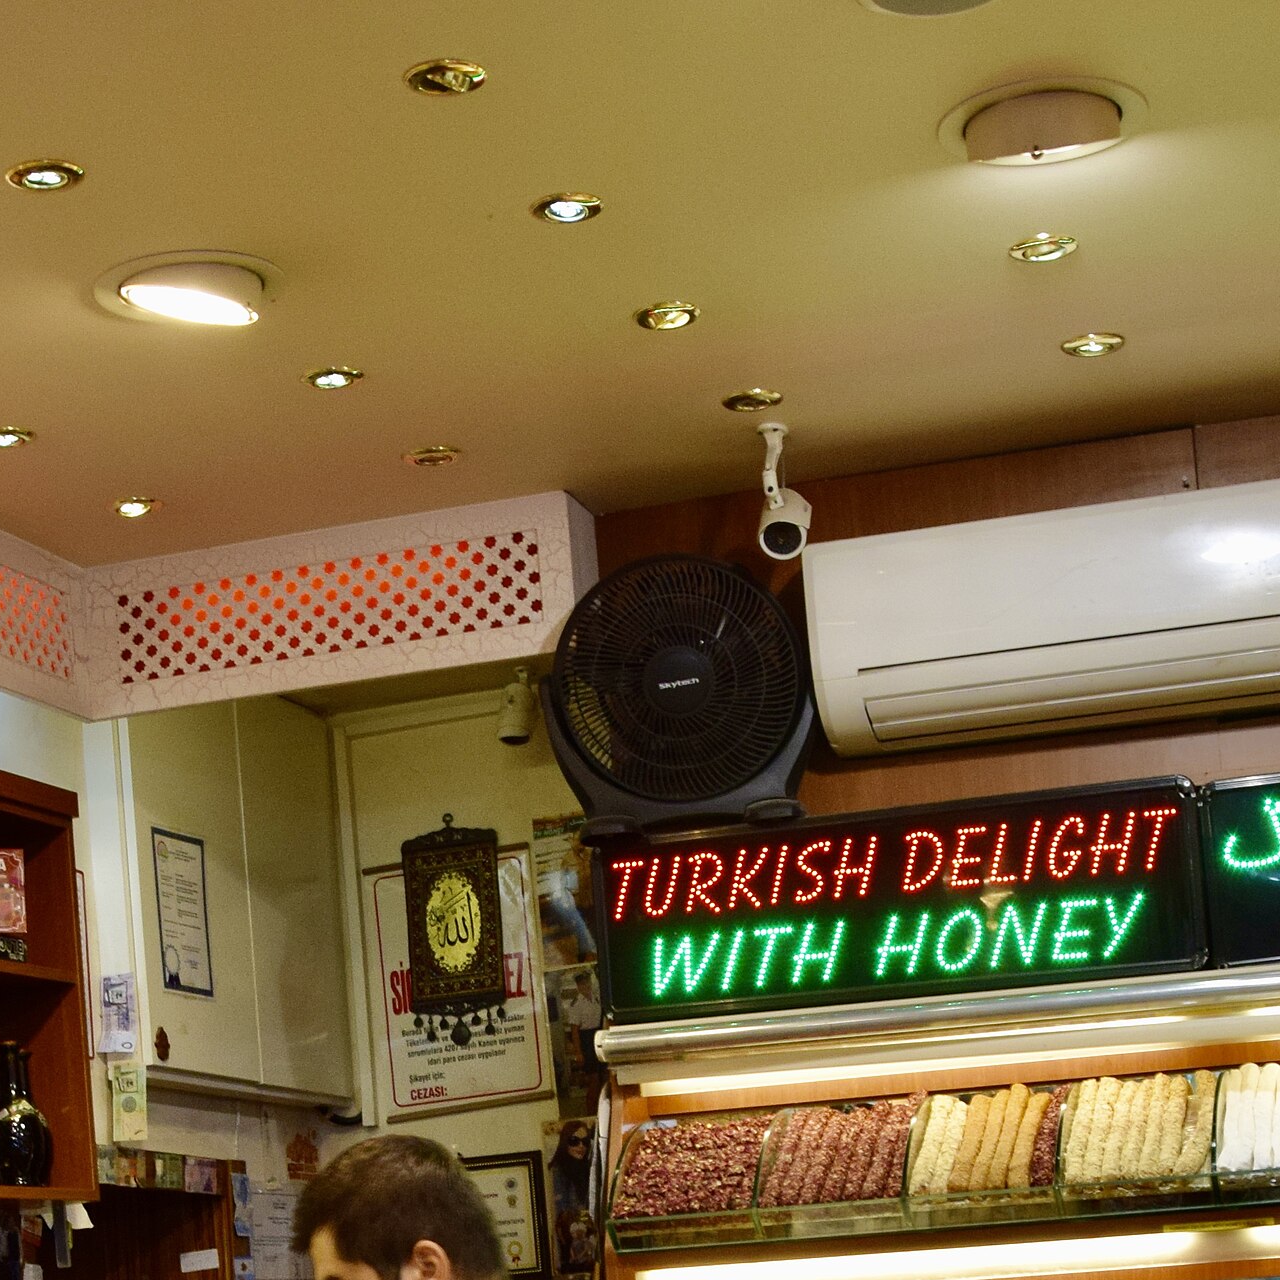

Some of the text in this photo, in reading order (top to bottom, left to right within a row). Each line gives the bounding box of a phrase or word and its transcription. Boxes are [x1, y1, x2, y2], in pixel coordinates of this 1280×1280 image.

[658, 677, 700, 690] Skytech
[610, 807, 1179, 921] TURKISH DELIGHT
[652, 889, 1147, 998] WITH HONEY
[410, 1086, 448, 1101] CEZASI:
